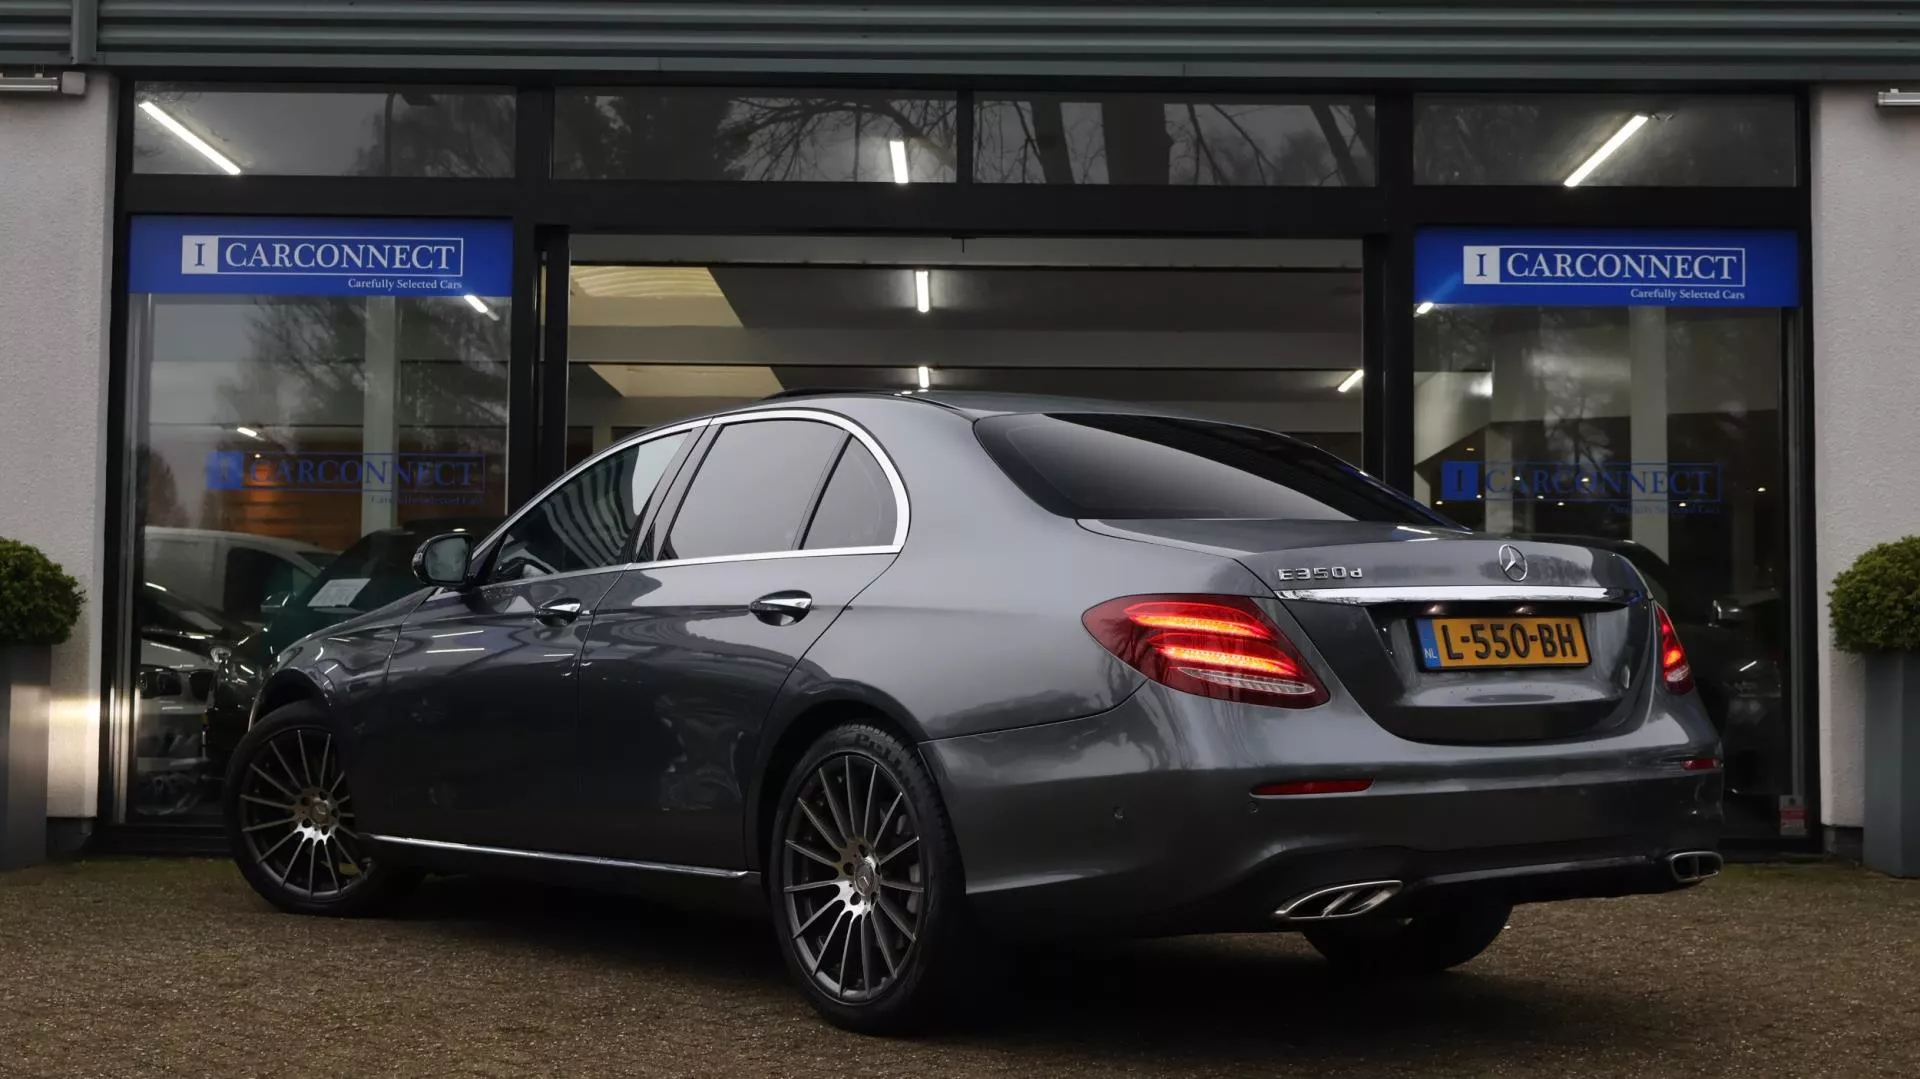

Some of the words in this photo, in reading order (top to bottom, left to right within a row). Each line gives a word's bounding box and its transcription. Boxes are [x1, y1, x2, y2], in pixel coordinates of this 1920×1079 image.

[194, 242, 206, 267] I
[225, 242, 455, 270] CARCONNECT
[1475, 252, 1487, 277] I
[1506, 252, 1737, 280] CARCONNECT
[348, 278, 394, 292] Carefully
[396, 279, 437, 290] Selected
[439, 280, 462, 290] Cars
[1630, 288, 1677, 302] Carefully
[1679, 289, 1719, 300] Selected
[1722, 289, 1745, 300] Cars
[251, 459, 479, 487] CARCONNECT
[1485, 468, 1713, 496] CARCONNECT
[1278, 567, 1363, 581] E350d
[1424, 648, 1438, 660] NL
[1441, 622, 1578, 660] L-550-BH
